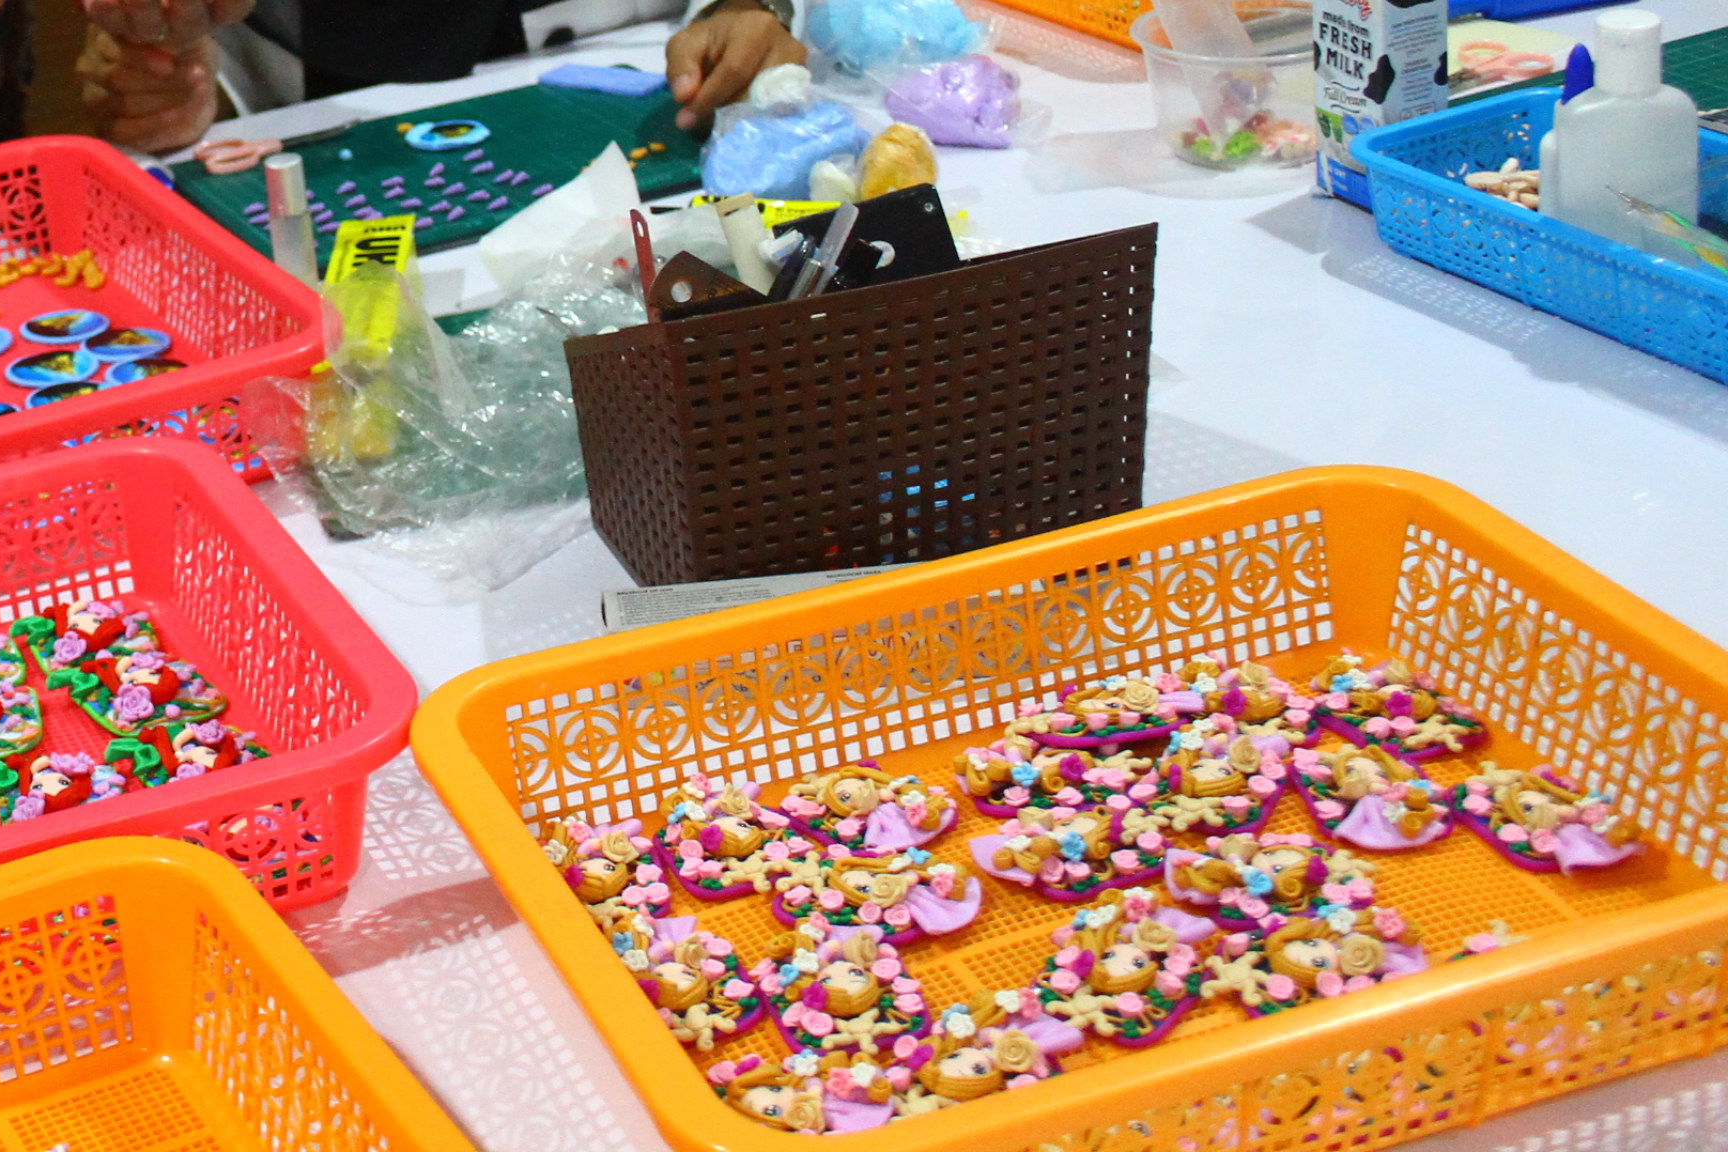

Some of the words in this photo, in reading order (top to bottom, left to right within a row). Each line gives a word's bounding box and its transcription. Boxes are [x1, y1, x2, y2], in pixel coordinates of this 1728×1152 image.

[1322, 10, 1346, 28] made
[1347, 19, 1369, 36] from
[1318, 22, 1372, 59] FRESH
[1326, 47, 1364, 80] MILK
